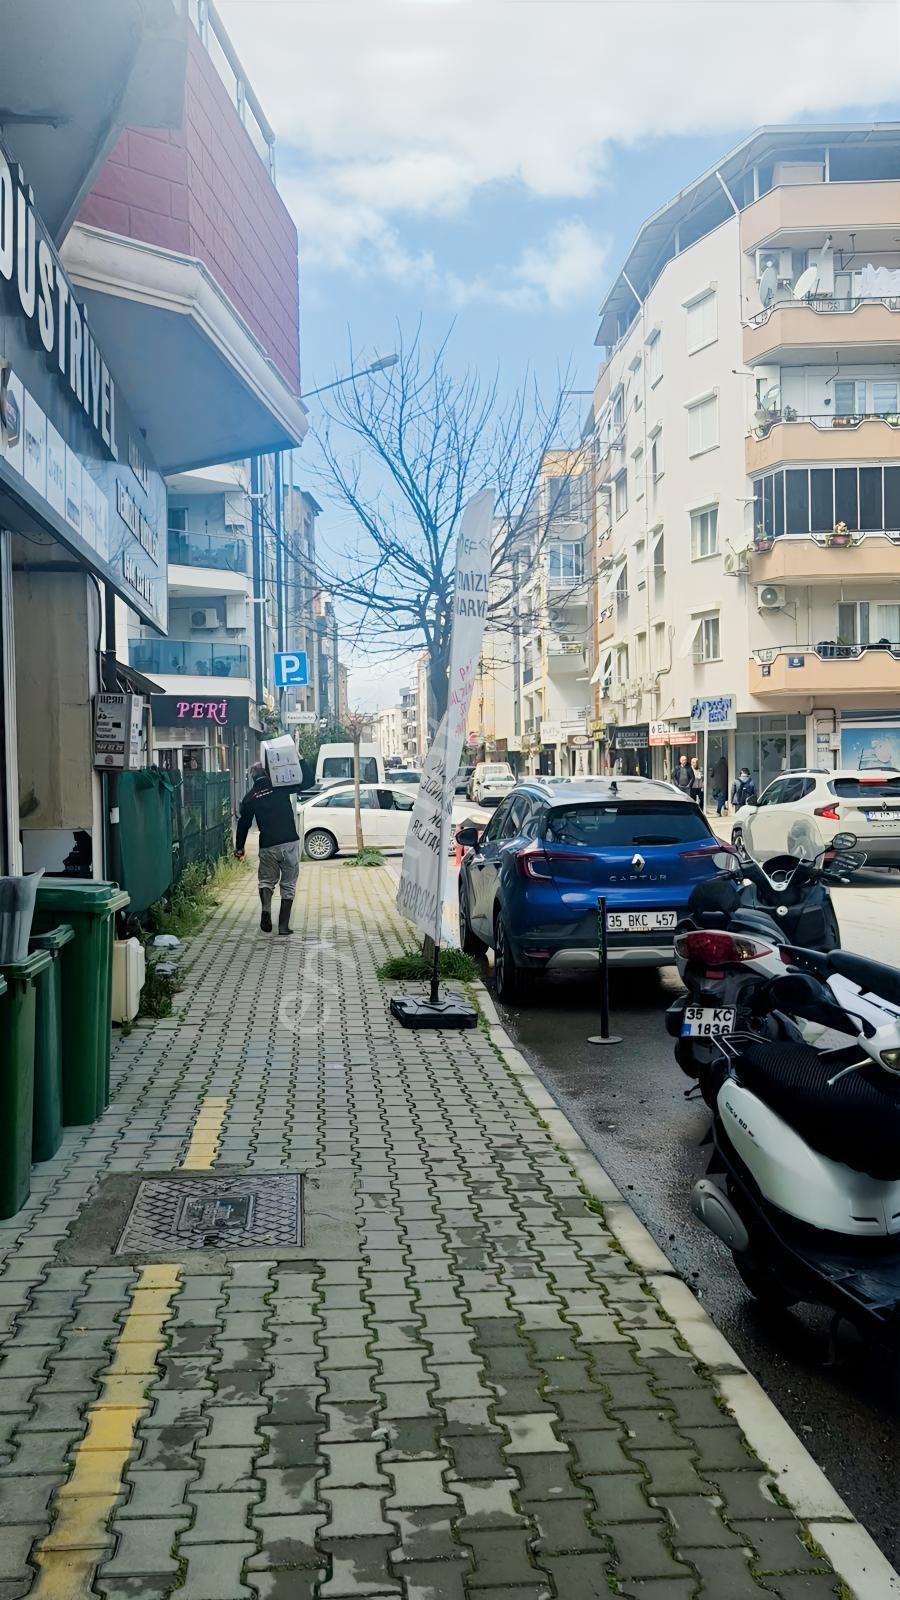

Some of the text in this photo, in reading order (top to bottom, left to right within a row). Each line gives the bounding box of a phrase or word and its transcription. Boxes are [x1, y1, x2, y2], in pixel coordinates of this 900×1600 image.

[281, 655, 299, 683] P
[176, 699, 228, 725] PERİ
[609, 874, 668, 882] CAPTUR
[608, 913, 675, 928] 35 BKC 457
[686, 1008, 733, 1021] 35 KC
[696, 1022, 731, 1035] 1836
